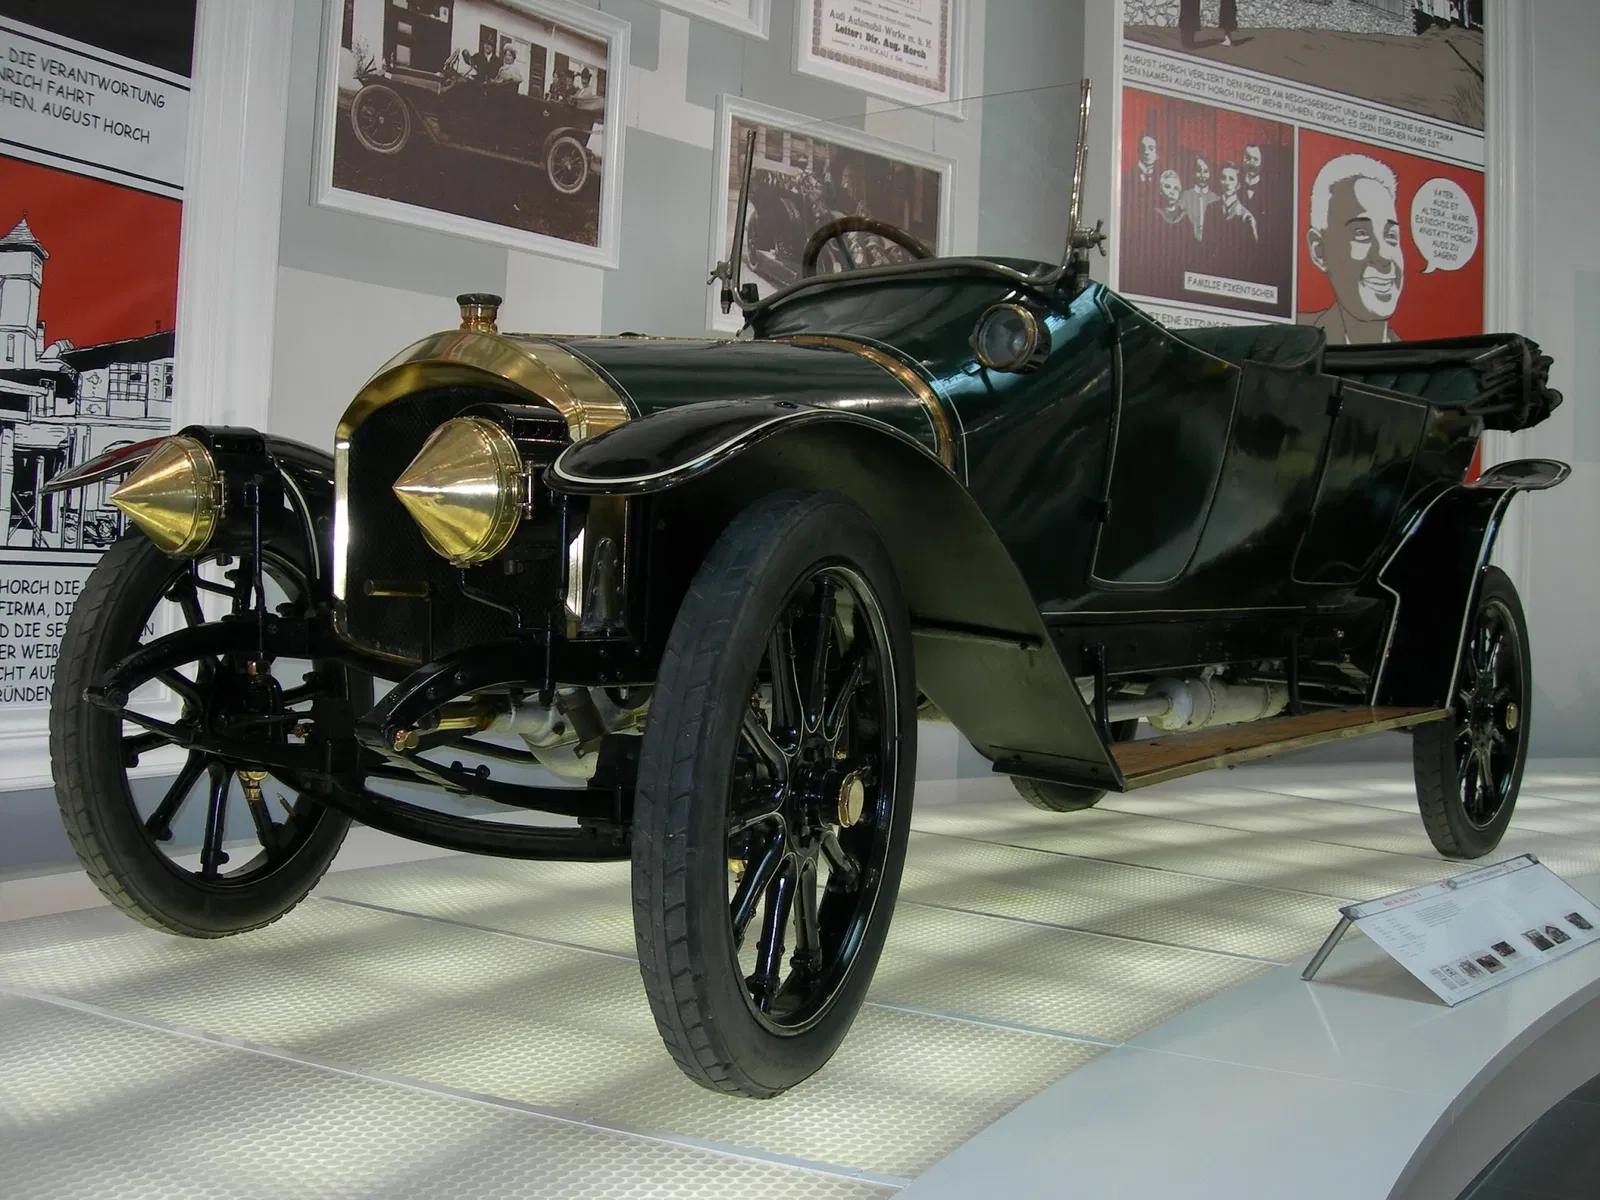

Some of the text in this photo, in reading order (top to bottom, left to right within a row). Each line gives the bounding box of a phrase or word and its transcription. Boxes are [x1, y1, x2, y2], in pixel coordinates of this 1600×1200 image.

[829, 9, 846, 22] Audi
[835, 23, 862, 39] Leiter:
[866, 33, 880, 45] Dir.
[883, 39, 901, 52] Aug.
[903, 45, 926, 59] Horch
[1124, 54, 1157, 67] AUGUST
[1159, 61, 1186, 74] HORCH
[9, 47, 166, 109] DIE VERANTWORTUNG
[1123, 64, 1141, 76] DEN
[1174, 77, 1206, 91] AUGUST
[1208, 84, 1235, 98] HORCH
[47, 80, 95, 106] FAHRT
[0, 87, 150, 144] HEN. AUGUST HORCH
[1187, 276, 1276, 299] FAMILIE FIKENTSCHER
[1162, 313, 1183, 325] EINE
[54, 580, 80, 596] DIE
[14, 622, 41, 638] DIE
[45, 622, 68, 638] SE
